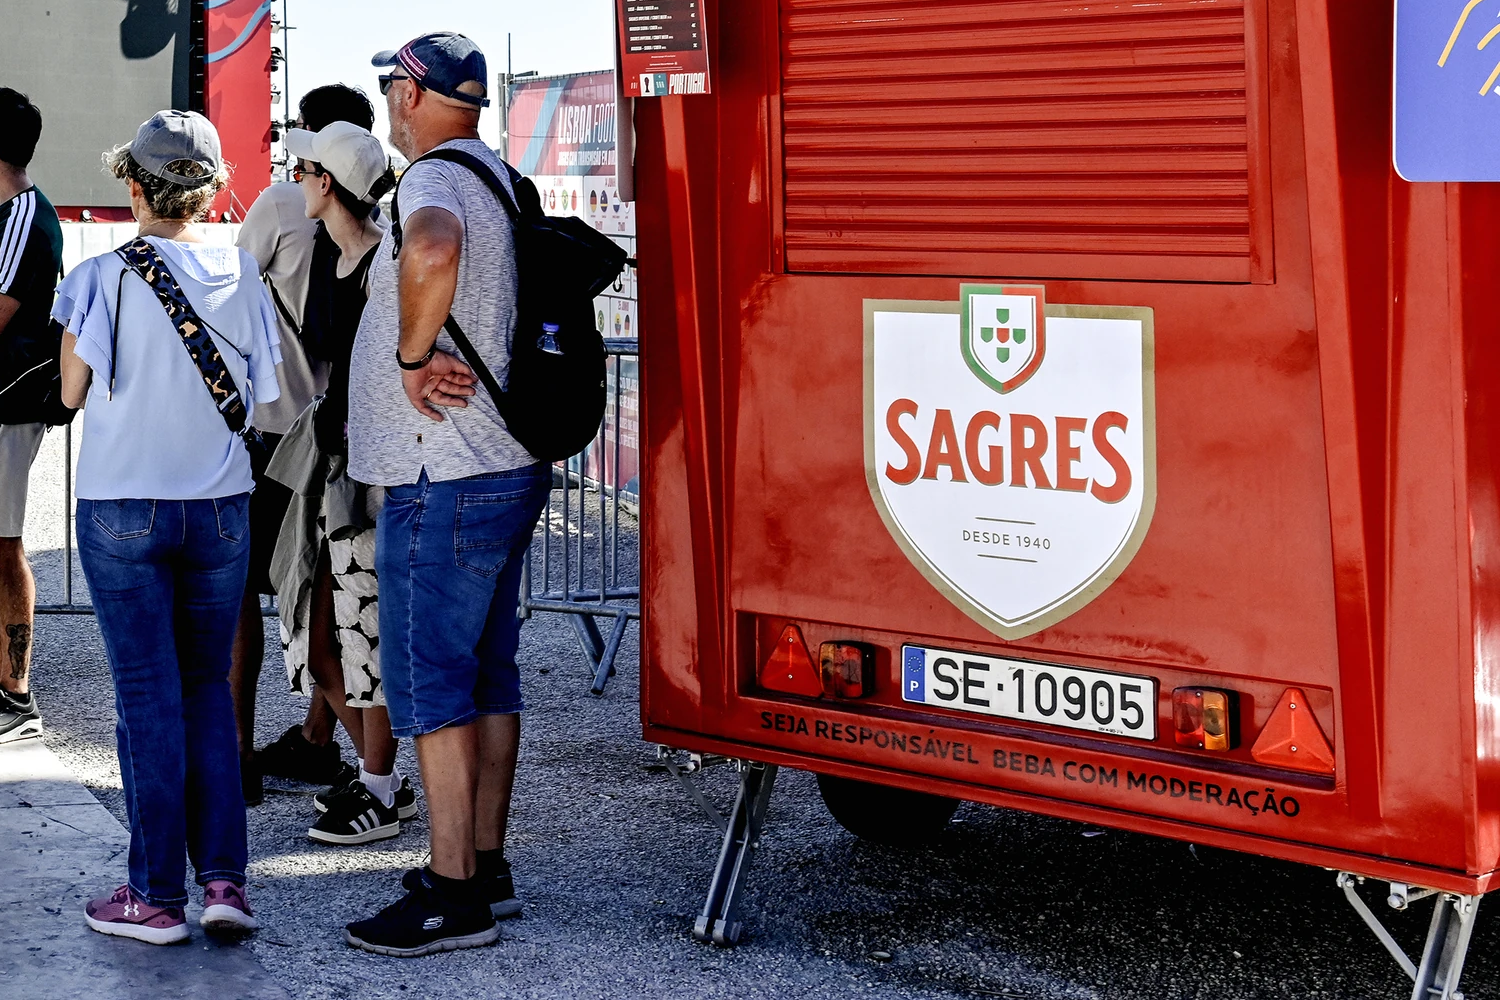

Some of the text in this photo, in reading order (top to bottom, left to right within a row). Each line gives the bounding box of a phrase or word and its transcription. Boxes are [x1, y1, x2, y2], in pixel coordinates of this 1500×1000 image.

[668, 72, 706, 95] PORTUGAL
[558, 104, 593, 144] LISBOA
[885, 398, 1132, 504] SAGRES
[962, 529, 1051, 550] DESDE 1940
[910, 680, 919, 692] P
[760, 710, 1301, 818] SEJA RESPONSÁVEL BEBA COM MODERAÇÃO
